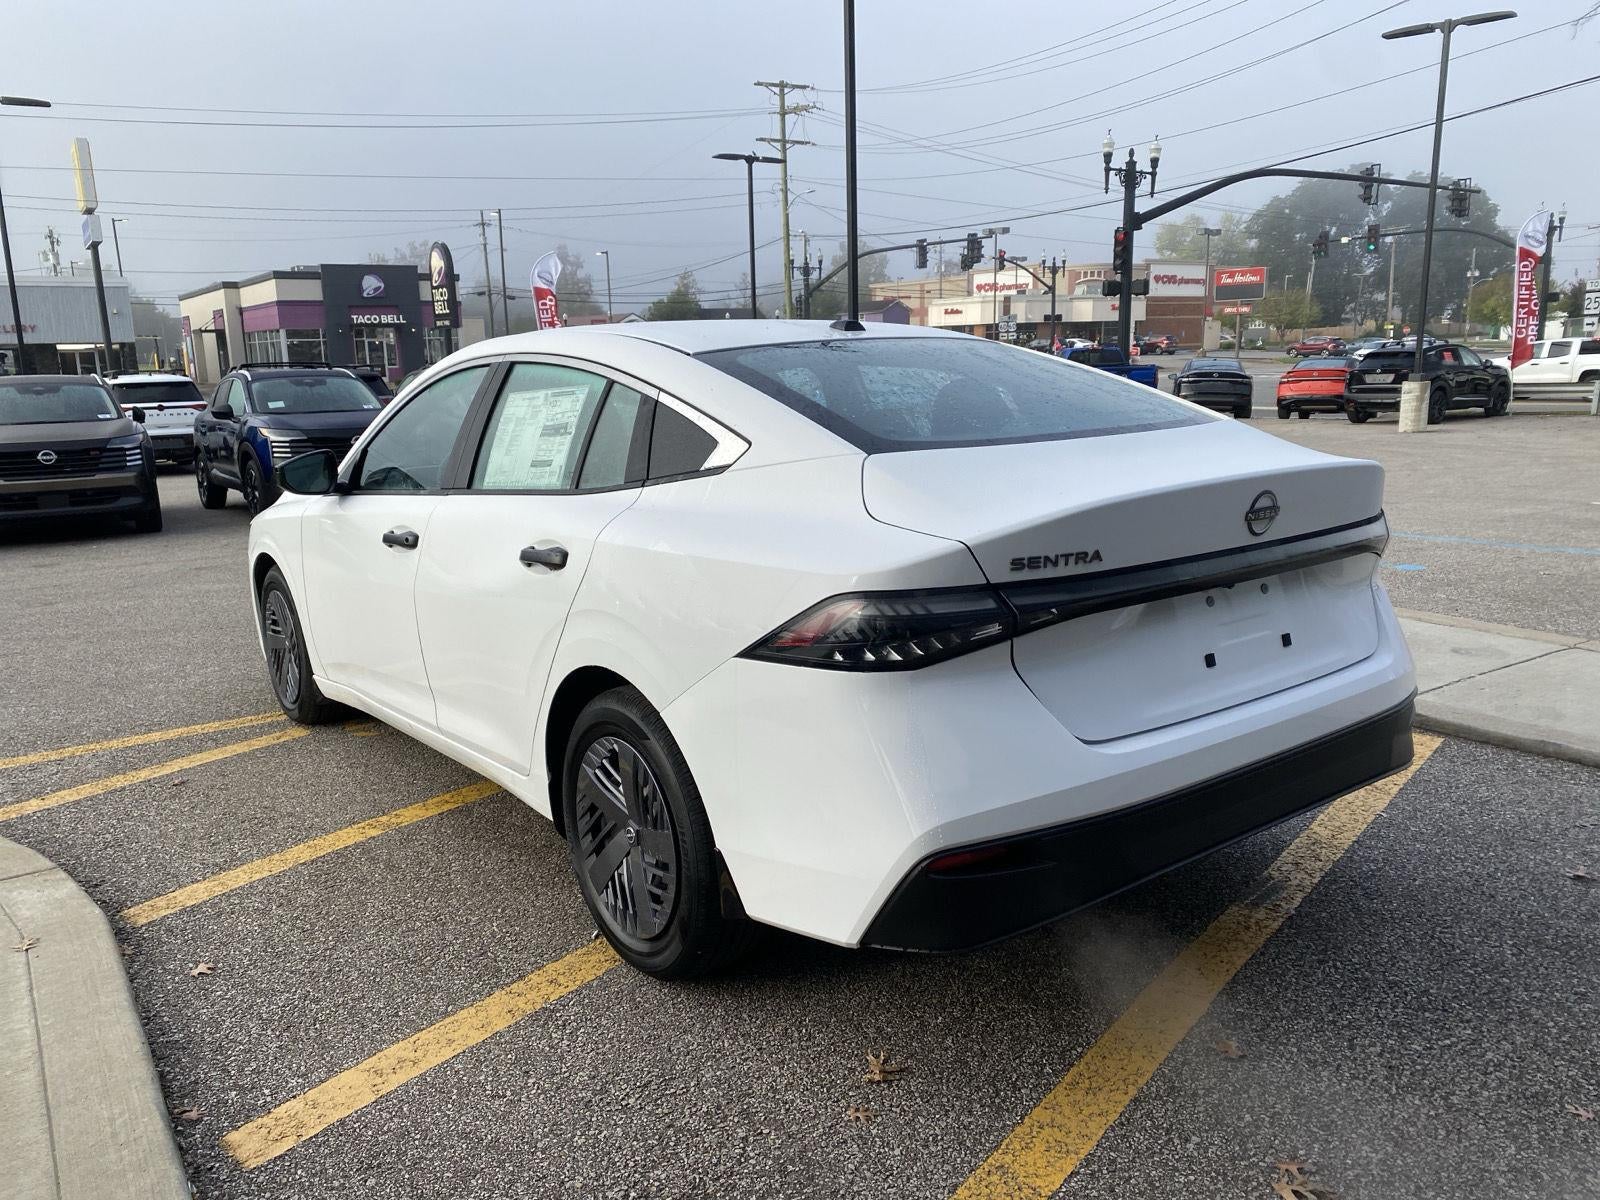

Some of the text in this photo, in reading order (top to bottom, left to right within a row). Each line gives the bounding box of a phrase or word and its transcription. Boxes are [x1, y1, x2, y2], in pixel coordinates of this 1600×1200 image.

[1160, 274, 1206, 287] CVS pharmacy
[1221, 272, 1260, 284] Tim Hortons
[432, 288, 448, 301] TACO
[1516, 261, 1532, 338] CERTIFIED
[434, 301, 450, 315] BELL
[351, 314, 407, 324] TACO BELL
[1009, 549, 1103, 572] SENTRA
